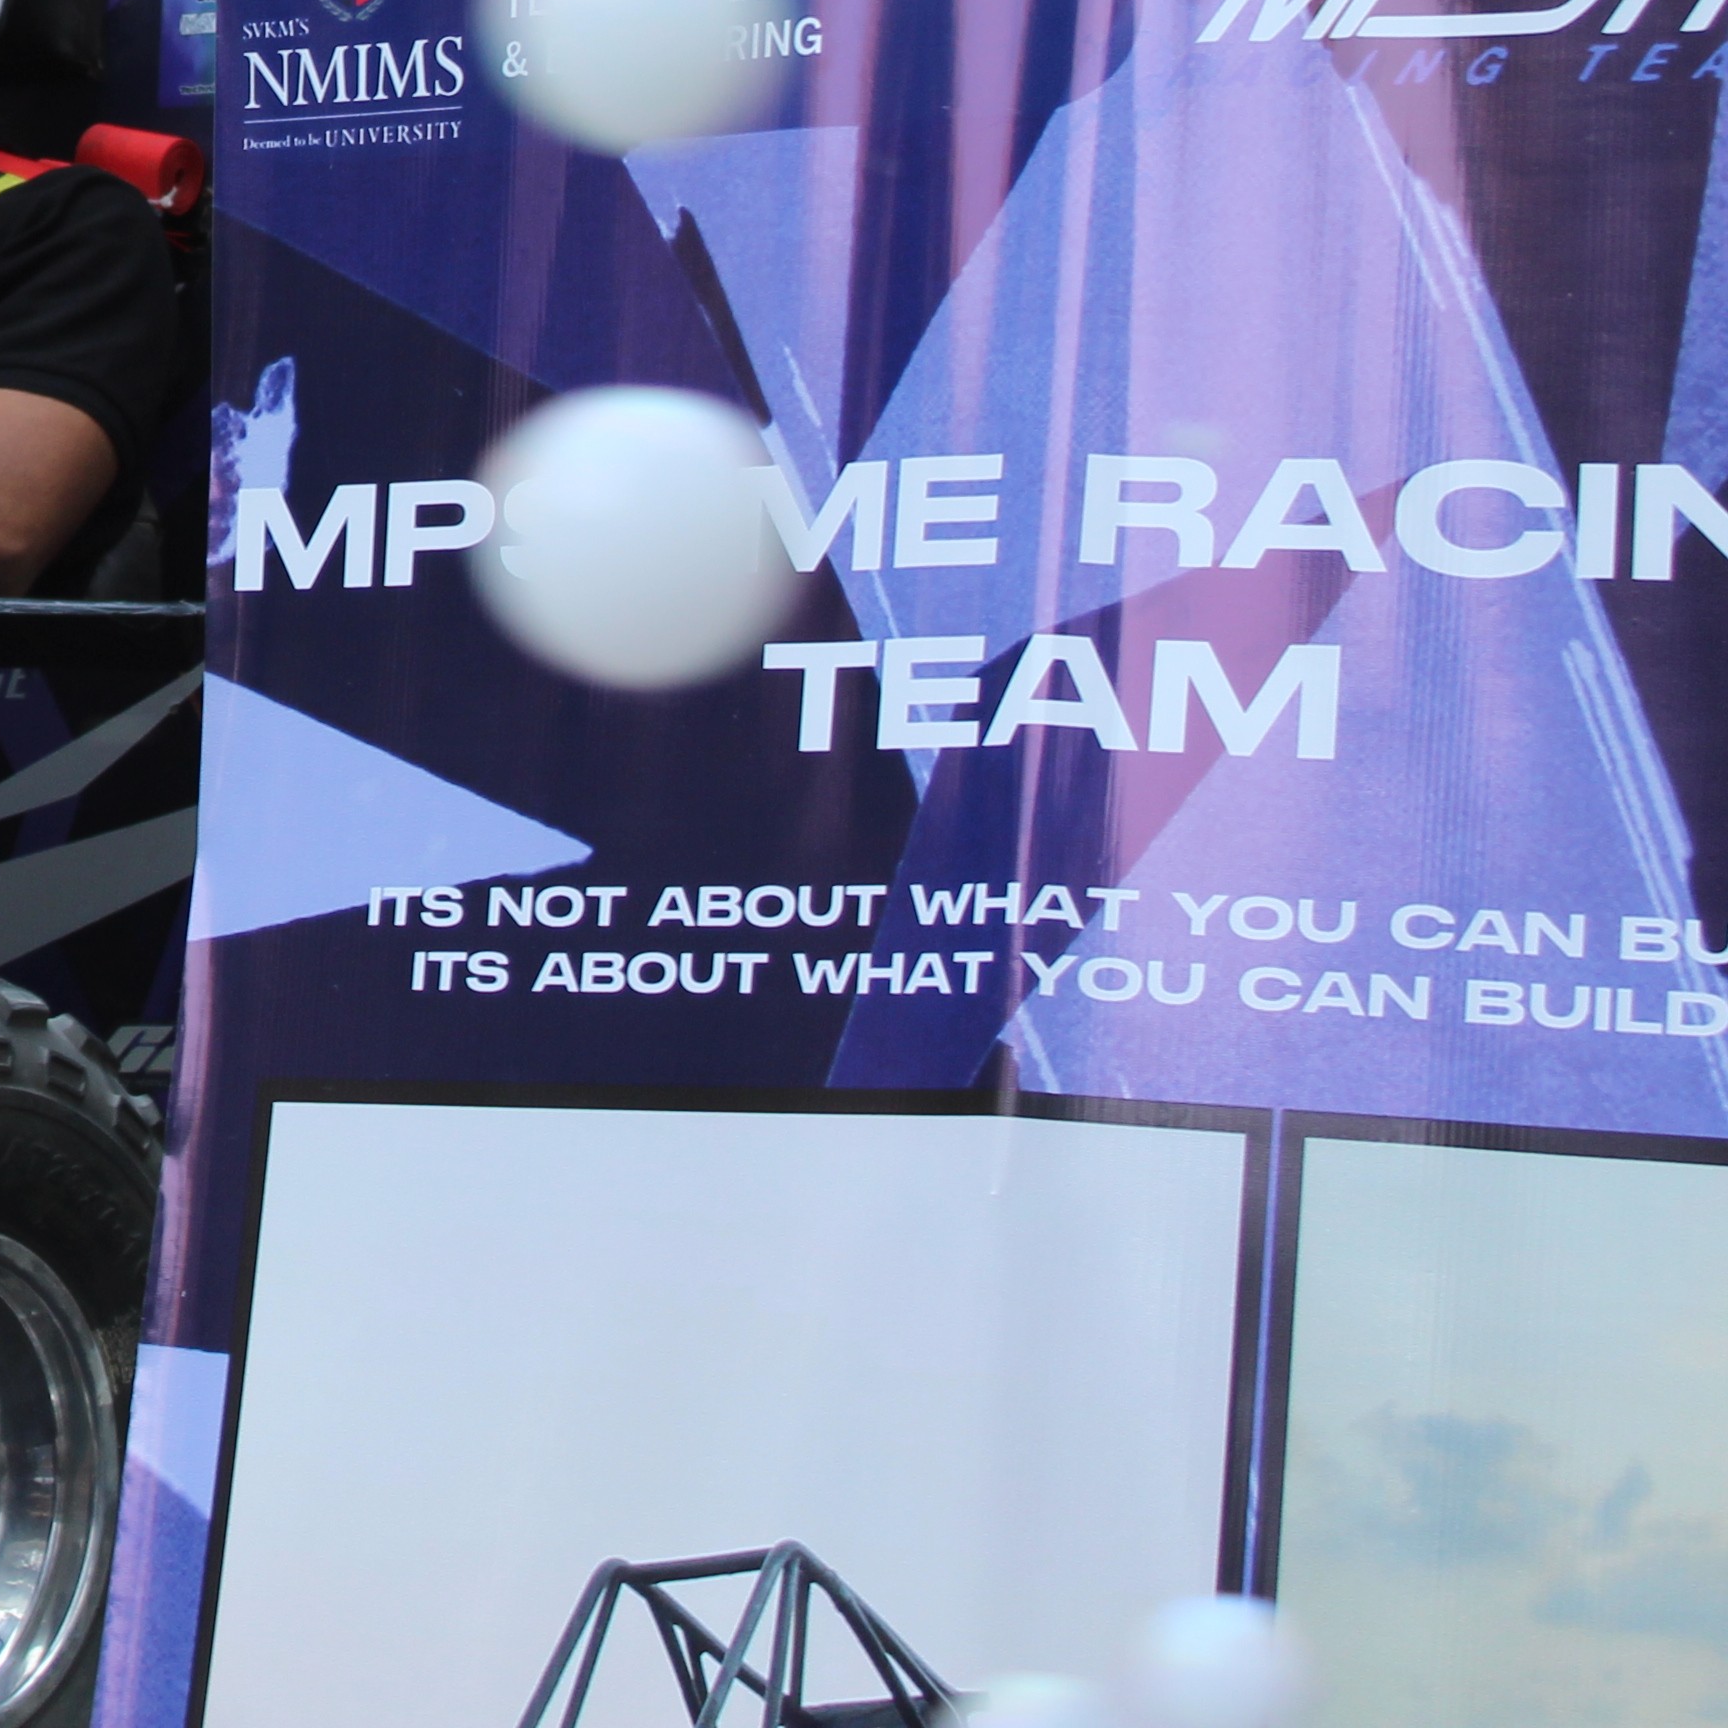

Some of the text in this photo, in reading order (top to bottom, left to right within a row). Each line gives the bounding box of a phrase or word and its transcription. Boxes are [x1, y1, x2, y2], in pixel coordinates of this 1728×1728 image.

[243, 17, 310, 40] SVKM'S
[502, 40, 529, 79] &
[244, 35, 465, 110] NMIMS
[244, 134, 291, 151] Deemed
[294, 136, 307, 148] to
[324, 120, 463, 149] UNIVERSITY
[234, 453, 1004, 591] MPME
[763, 633, 1342, 760] TEAM
[367, 885, 464, 927] ITS
[486, 885, 627, 928] NOT
[647, 884, 886, 928] ABOUT
[912, 883, 1140, 933] WHAT
[1172, 891, 1357, 943] YOU
[1390, 903, 1589, 959] CAN
[411, 951, 1728, 1038] ITS ABOUT WHAT YOU CAN BUILD
